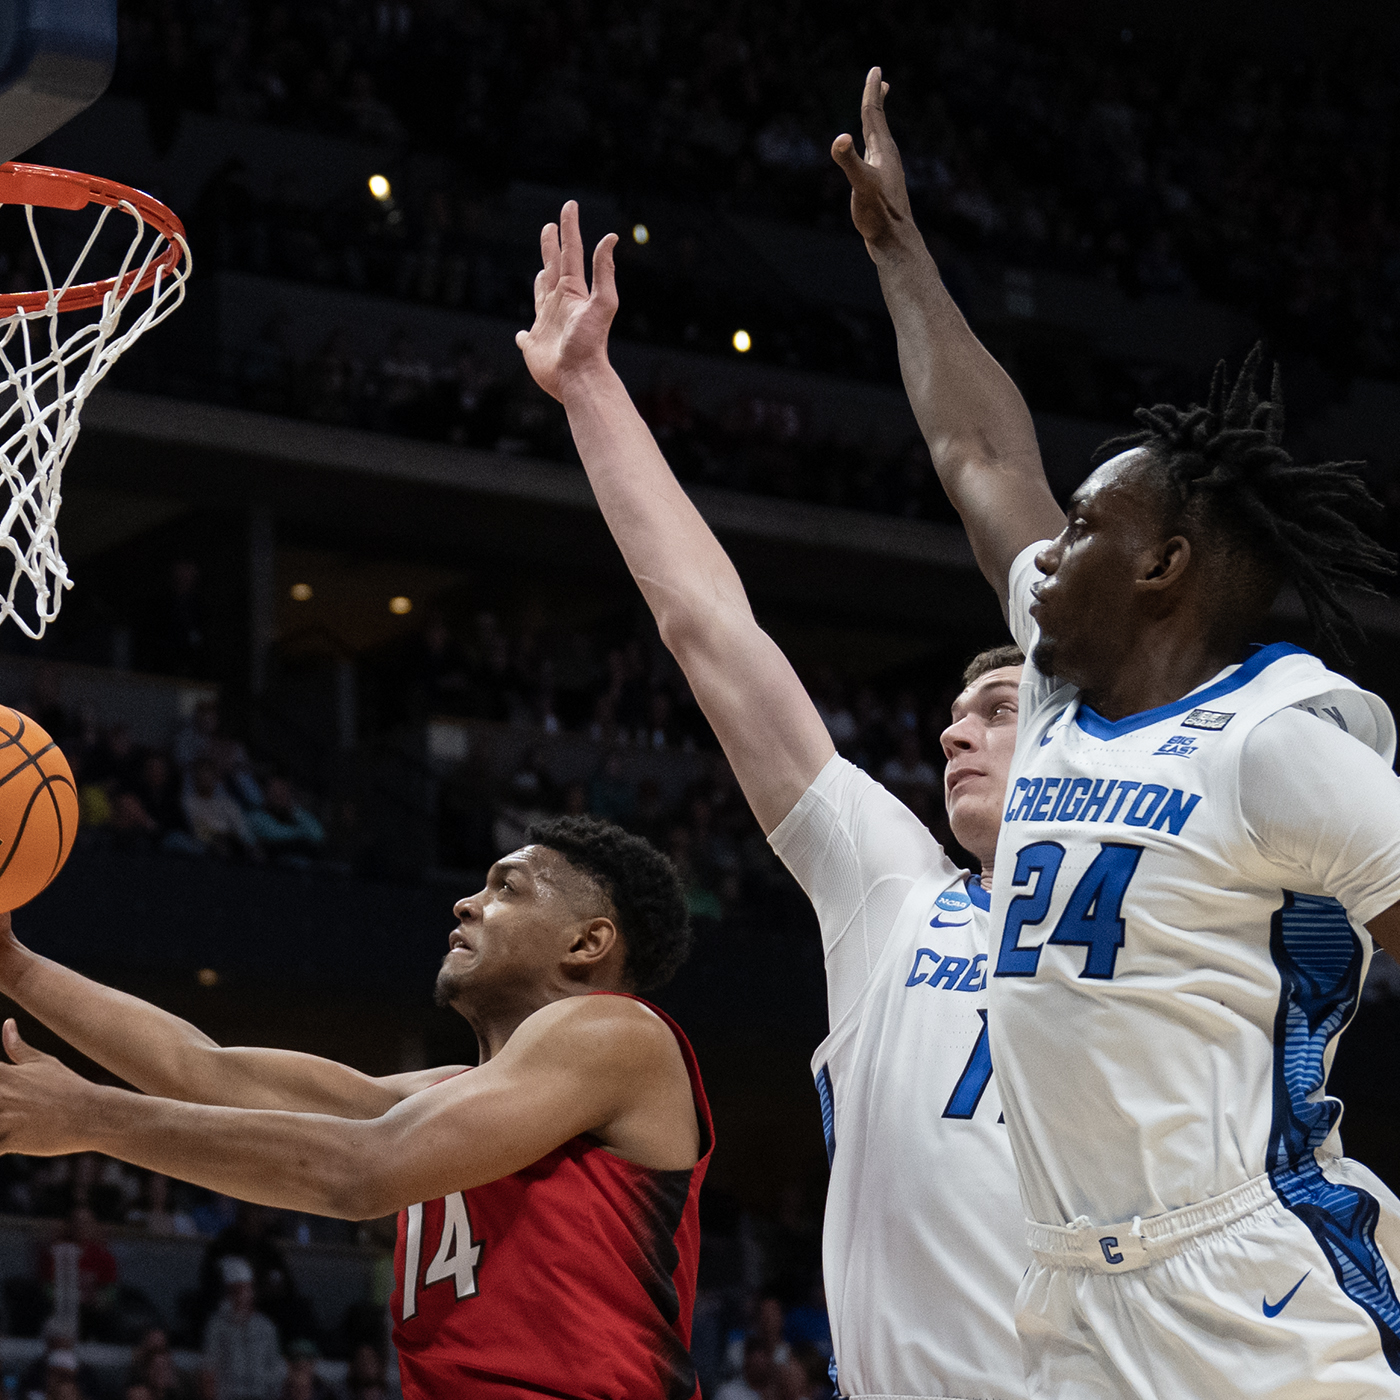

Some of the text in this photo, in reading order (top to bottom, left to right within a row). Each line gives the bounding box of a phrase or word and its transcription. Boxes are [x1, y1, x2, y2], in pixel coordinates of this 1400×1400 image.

[1157, 746, 1199, 757] EAST
[1166, 735, 1198, 746] BIG
[1003, 777, 1202, 836] CREIGHTON
[937, 896, 968, 908] NCAA
[993, 840, 1145, 980] 24
[402, 1190, 487, 1324] 14
